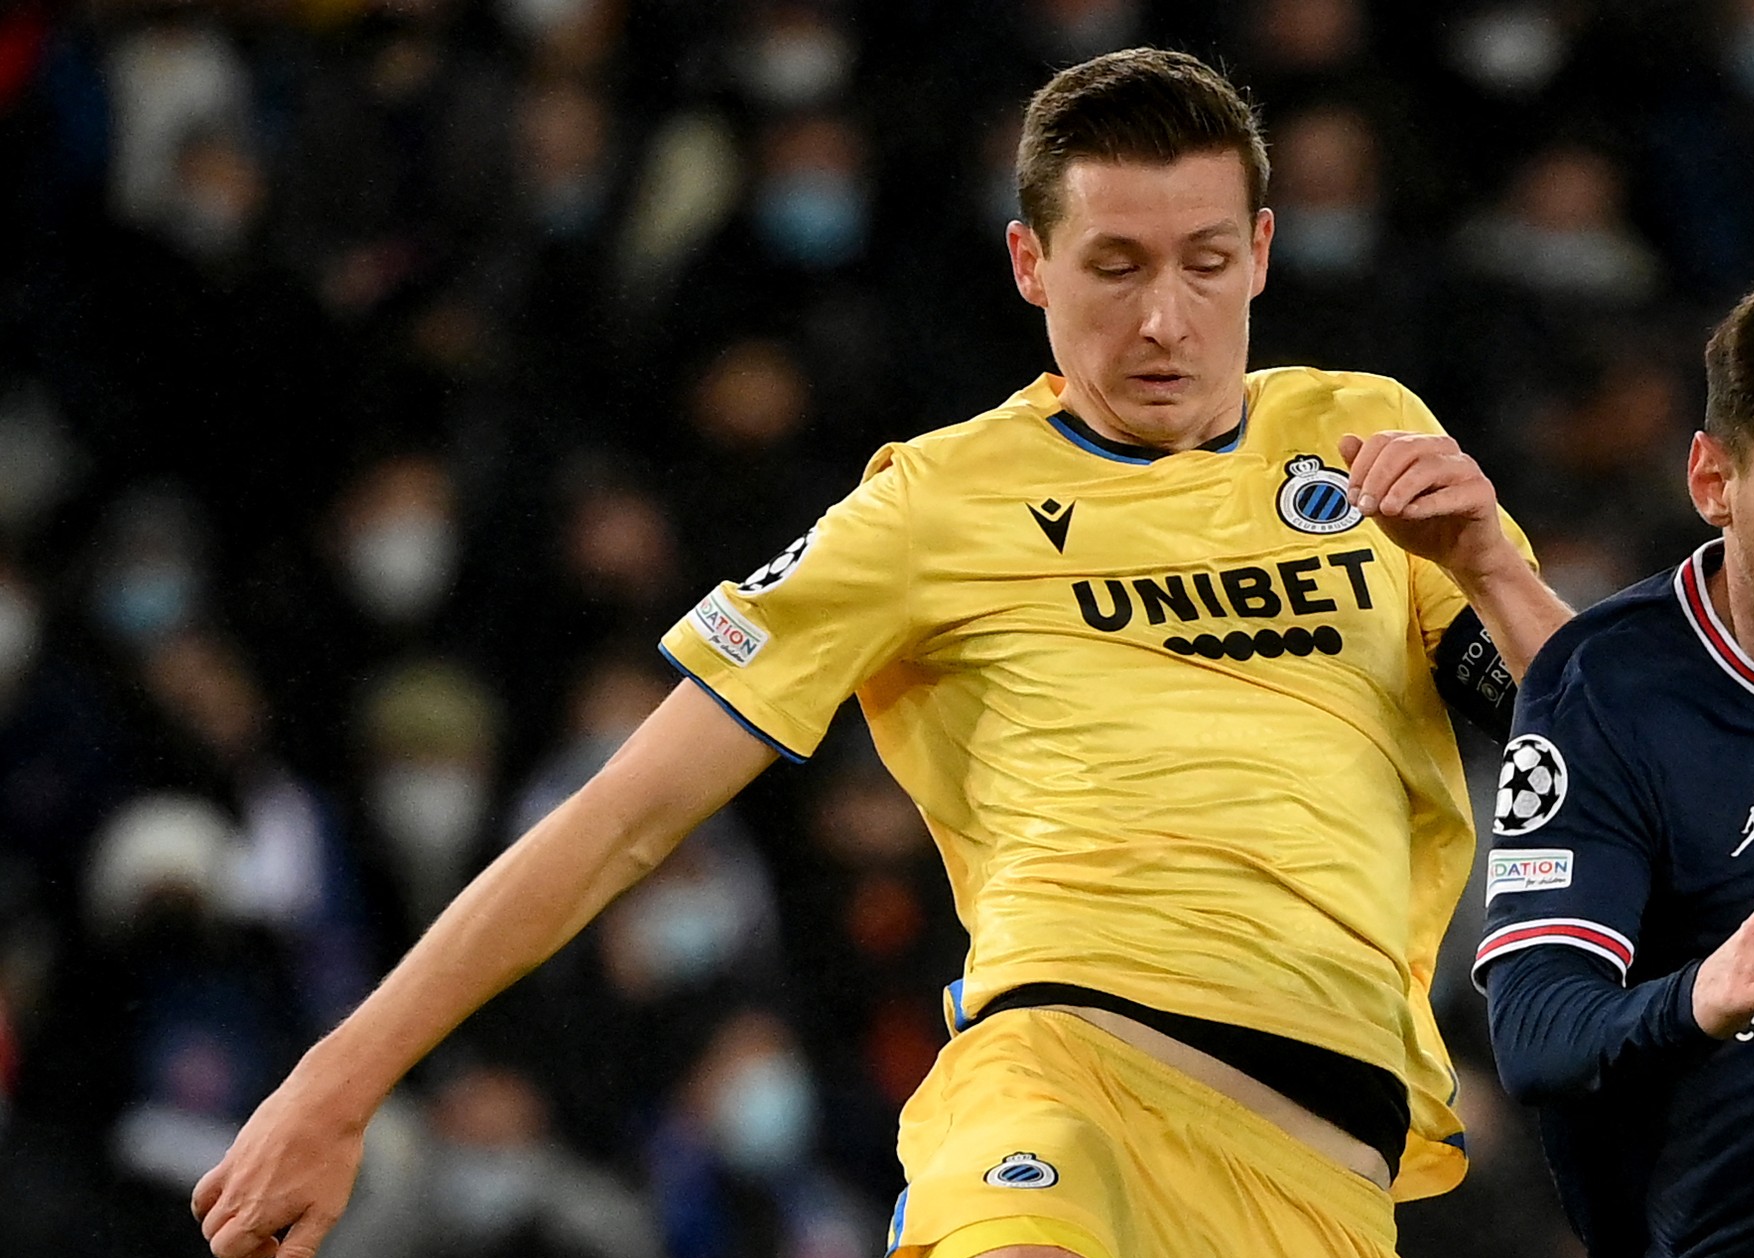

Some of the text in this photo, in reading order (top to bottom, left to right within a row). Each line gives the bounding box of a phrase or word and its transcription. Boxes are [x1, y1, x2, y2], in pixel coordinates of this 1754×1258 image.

[1071, 548, 1375, 632] UNIBET
[1462, 642, 1483, 666] TO
[1491, 861, 1568, 877] DATION
